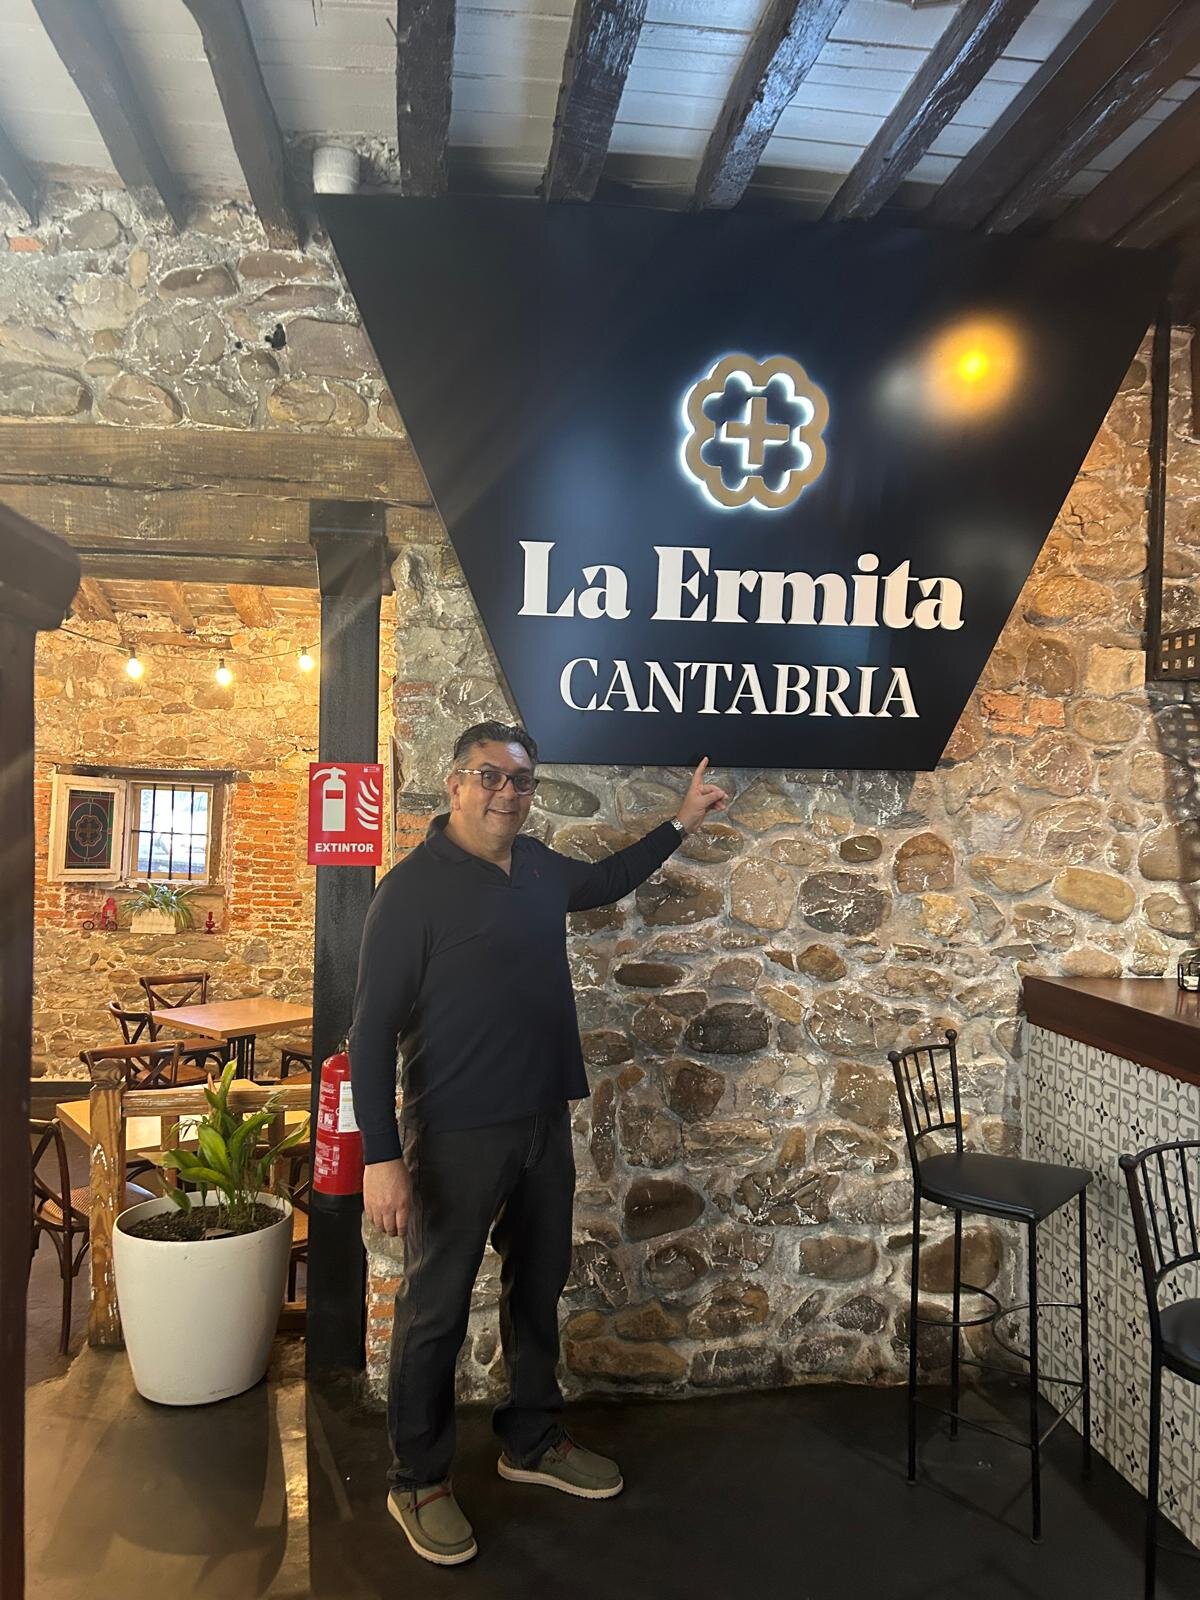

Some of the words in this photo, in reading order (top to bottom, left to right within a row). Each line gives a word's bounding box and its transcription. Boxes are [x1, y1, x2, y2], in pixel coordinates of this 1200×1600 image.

[517, 540, 632, 620] La
[650, 545, 965, 631] Ermita
[559, 657, 920, 718] CANTABRIA
[314, 842, 374, 853] EXTINTOR
